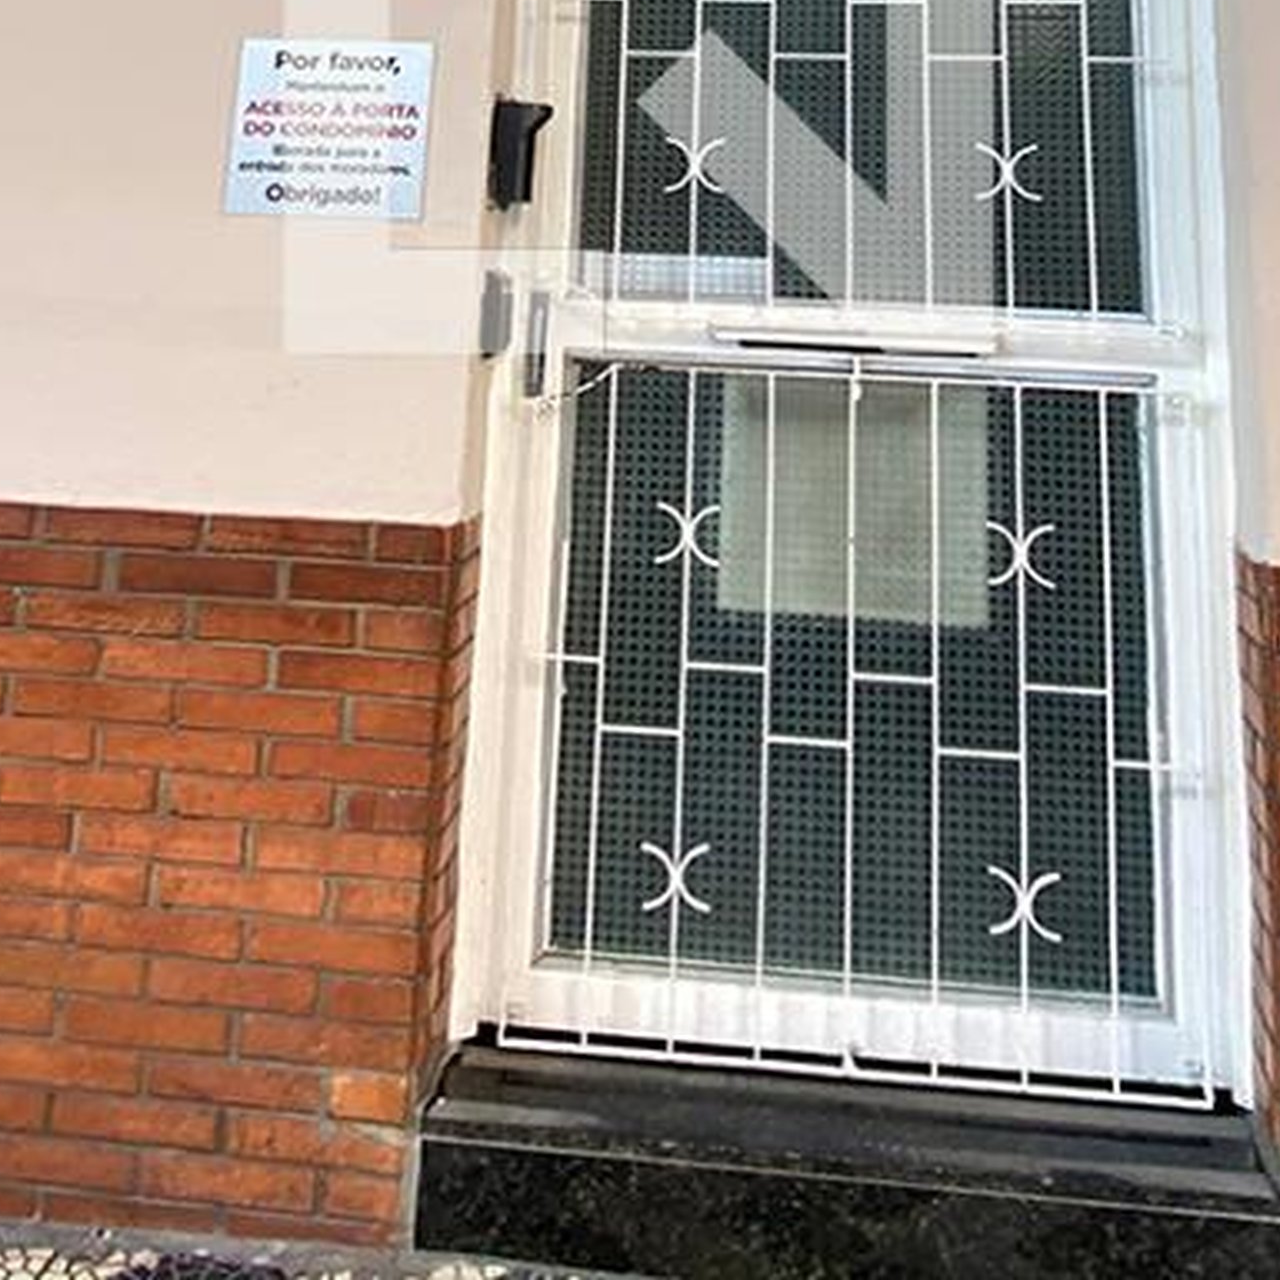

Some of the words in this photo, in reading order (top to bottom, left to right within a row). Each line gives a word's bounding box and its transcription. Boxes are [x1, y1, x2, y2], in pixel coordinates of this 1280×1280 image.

[274, 50, 320, 70] Por
[329, 52, 402, 75] favor,
[244, 100, 325, 118] ACESSO
[351, 102, 420, 120] PORTA
[242, 120, 276, 138] DO
[265, 182, 382, 208] Obrigado!
